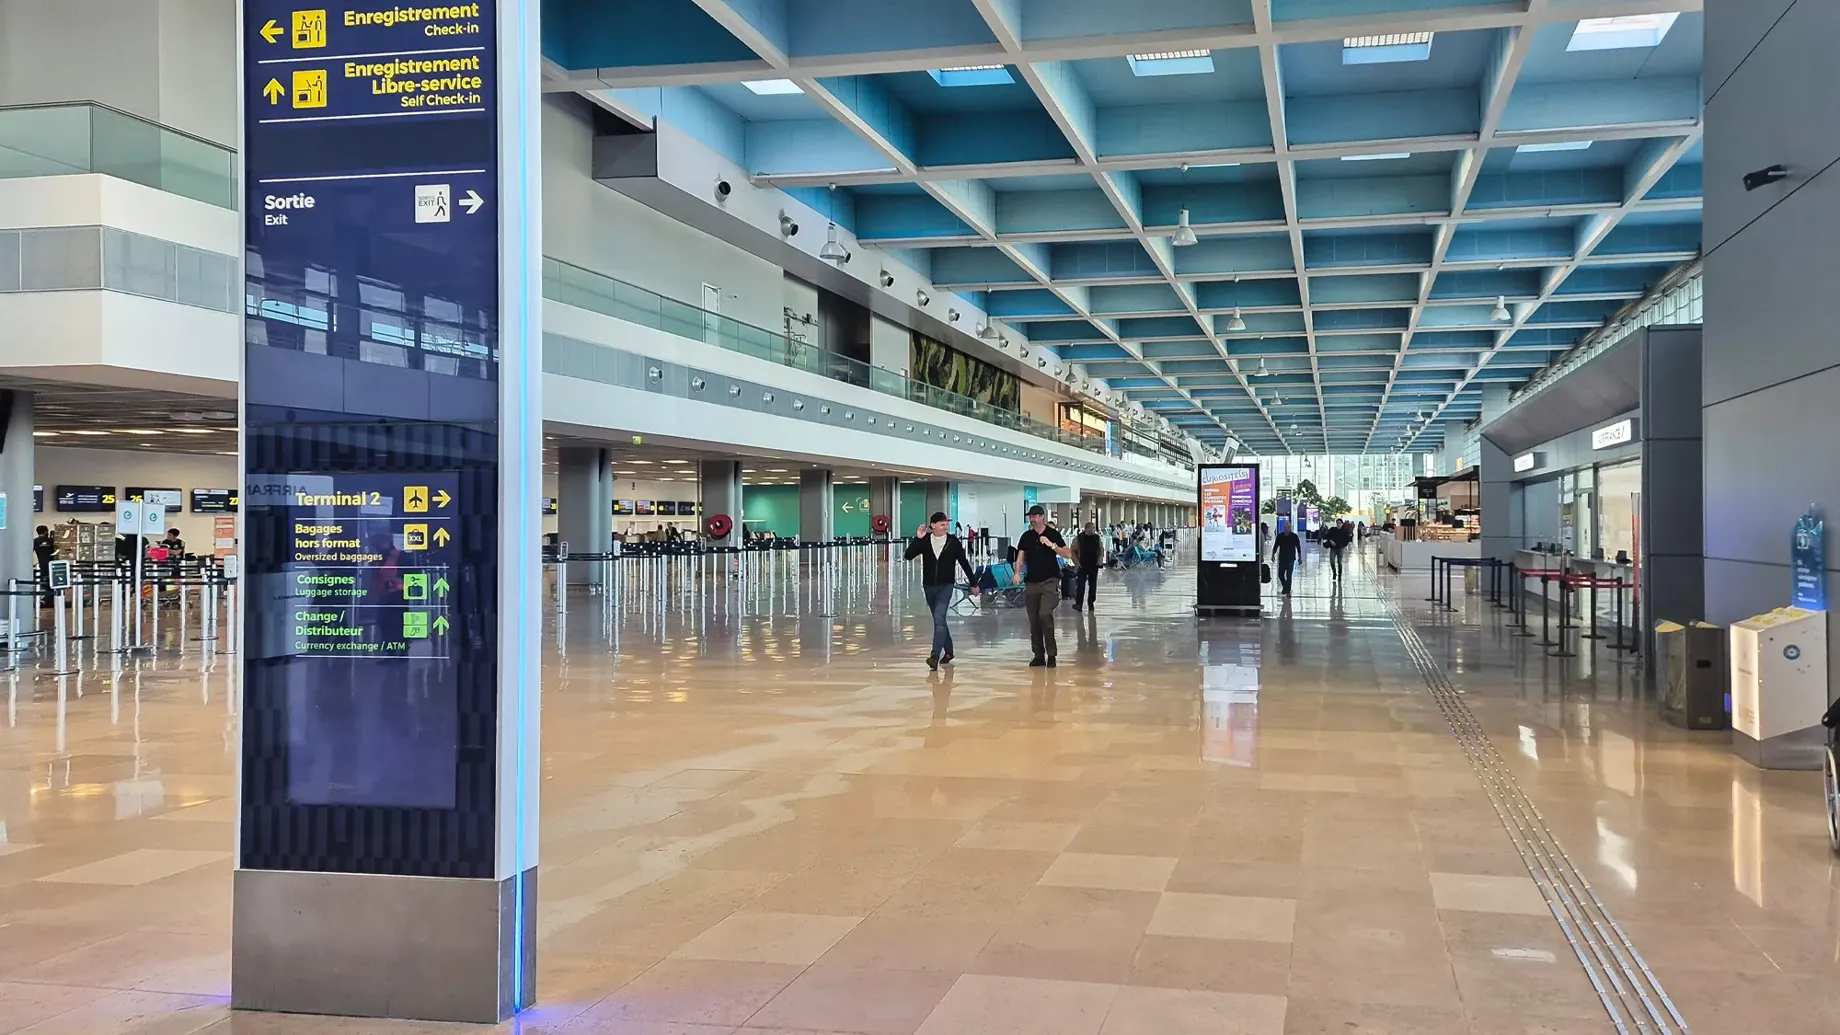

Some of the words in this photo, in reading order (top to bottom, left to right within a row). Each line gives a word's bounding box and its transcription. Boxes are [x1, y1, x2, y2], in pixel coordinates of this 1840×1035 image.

[344, 2, 479, 27] Enregistrement
[424, 22, 479, 37] Check-in
[344, 55, 479, 79] Enregistrement
[372, 74, 481, 95] Libre-service
[400, 95, 425, 108] Self
[426, 92, 480, 106] Check-in
[264, 193, 315, 210] Sortie
[264, 213, 288, 226] Exit
[102, 494, 115, 504] 25
[295, 491, 366, 506] Terminal
[370, 492, 381, 506] 2
[295, 524, 343, 536] Bagages
[295, 538, 319, 548] hors
[322, 538, 361, 548] format
[408, 534, 423, 543] XXL
[295, 552, 338, 561] Oversized
[339, 552, 383, 563] baggages
[296, 574, 355, 587] Consignes
[295, 587, 333, 598] Luggage
[334, 588, 368, 598] storage
[295, 611, 337, 623] Change
[339, 610, 345, 622] /
[295, 625, 363, 637] Distributeur
[295, 641, 334, 652] Currency
[336, 641, 379, 652] exchange
[381, 641, 386, 651] /
[387, 642, 406, 650] ATM
